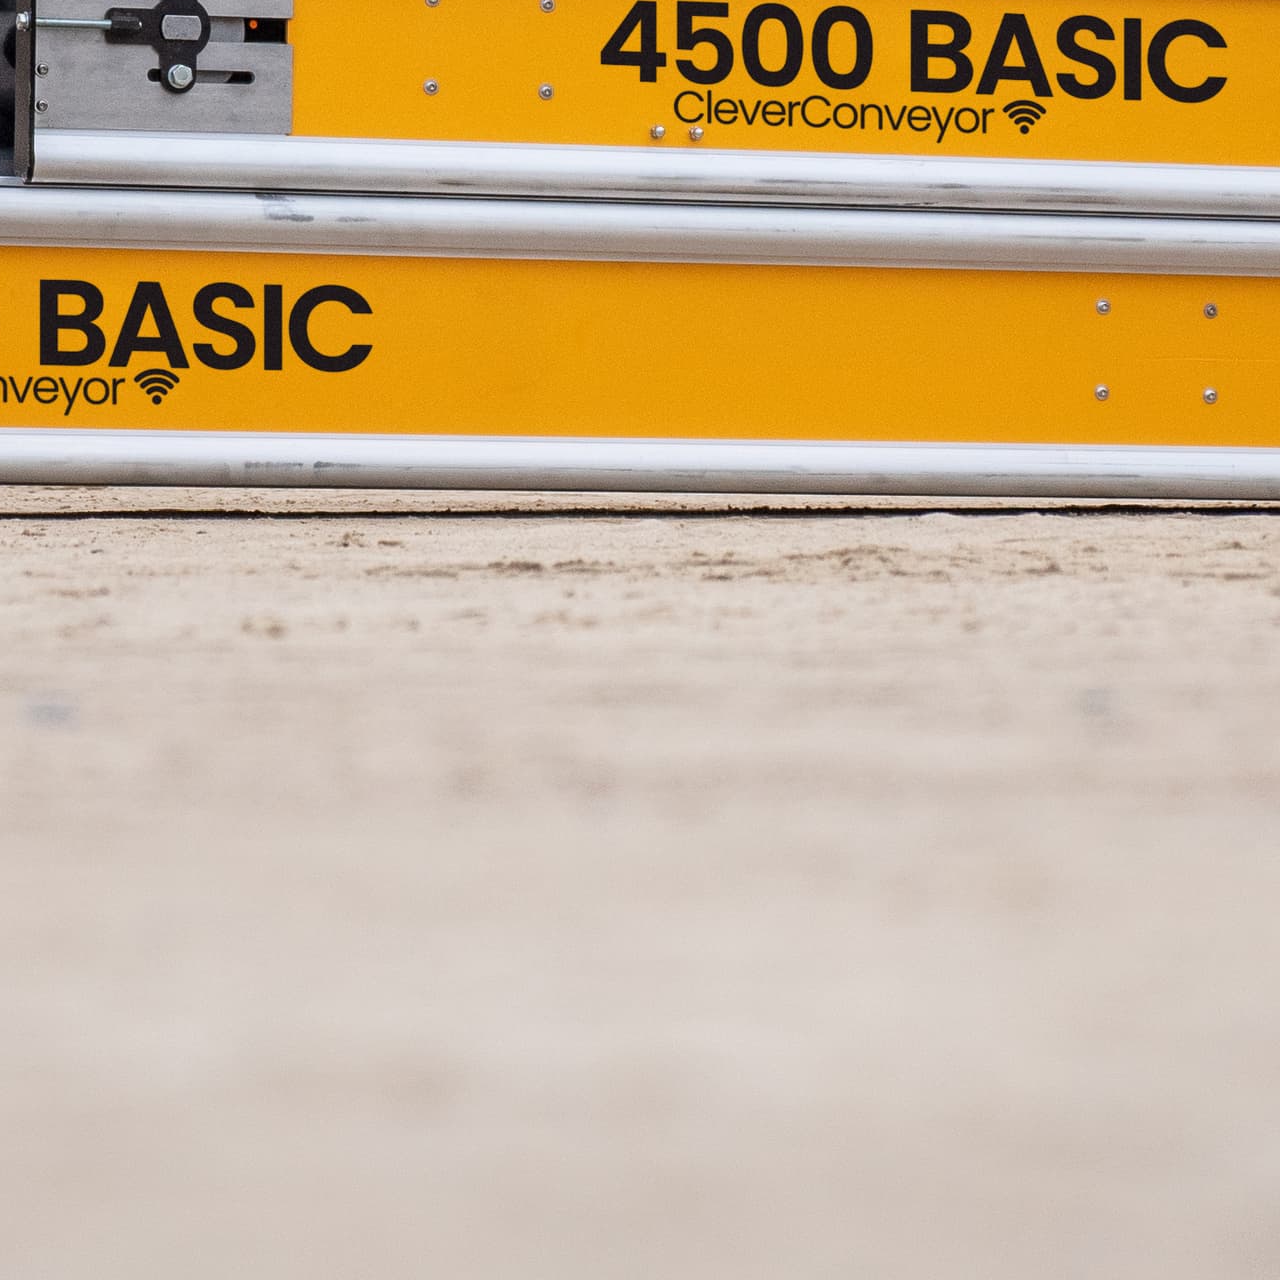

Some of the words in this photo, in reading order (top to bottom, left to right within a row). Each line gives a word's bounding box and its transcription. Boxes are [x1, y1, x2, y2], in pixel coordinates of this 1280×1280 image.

[600, 0, 874, 90] 4500
[910, 9, 1228, 104] BASIC
[673, 90, 995, 144] CleverConveyor
[39, 279, 373, 373] BASIC
